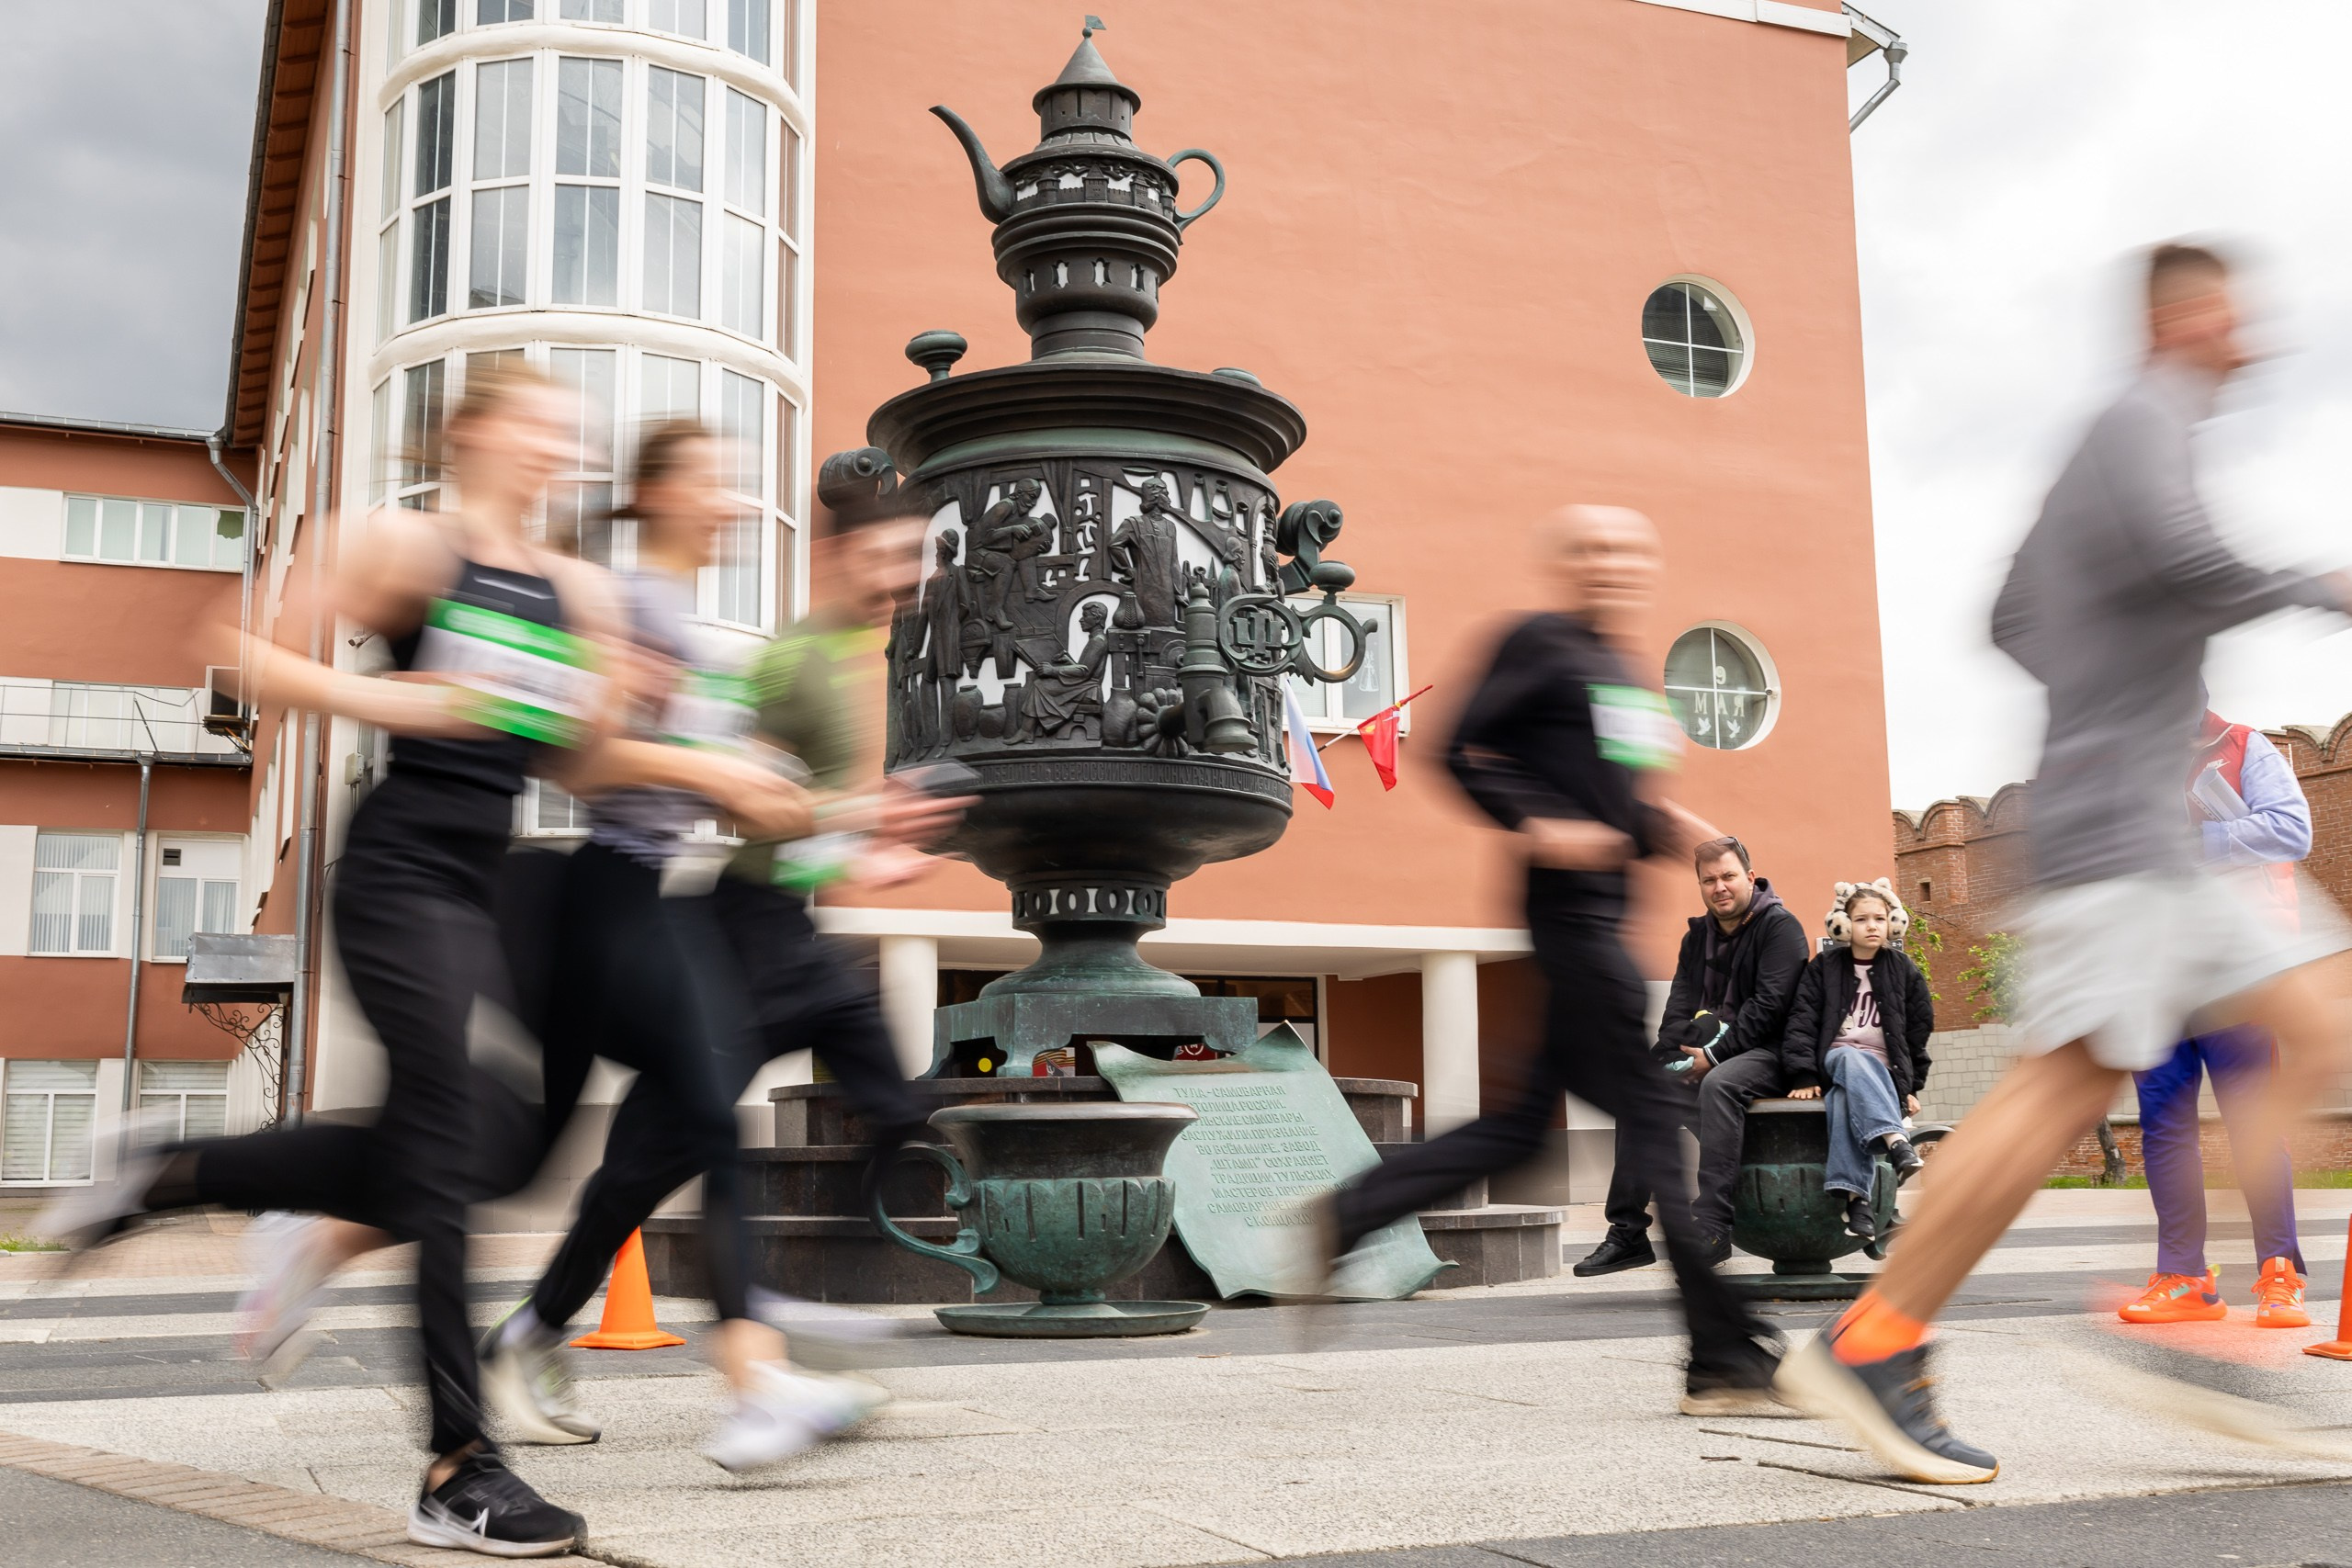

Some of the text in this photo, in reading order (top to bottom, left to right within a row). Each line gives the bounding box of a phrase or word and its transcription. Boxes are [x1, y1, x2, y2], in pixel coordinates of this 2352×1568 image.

[1715, 665, 1726, 684] 9
[1694, 692, 1745, 716] МАЯ
[1157, 764, 1209, 787] КОНКУРСА
[1210, 769, 1224, 788] НА
[1238, 1100, 1286, 1111] РОССИИ.
[1190, 1111, 1305, 1126] ЛЬСКИЕ САМОВАРЫ
[1181, 1125, 1319, 1141] ЗАСЛУЖИЛИ ПРИЗНАНИЕ
[1196, 1145, 1213, 1155] ВО
[1280, 1140, 1322, 1153] ЗАВОД
[1263, 1155, 1329, 1168] СОХРАНЯЕТ
[1211, 1168, 1337, 1185] ТРАДИЦИИ ТУЛЬСКИХ
[1207, 1201, 1285, 1213] САМОВАРНОЕ
[1251, 1214, 1295, 1227] КОНЦА
